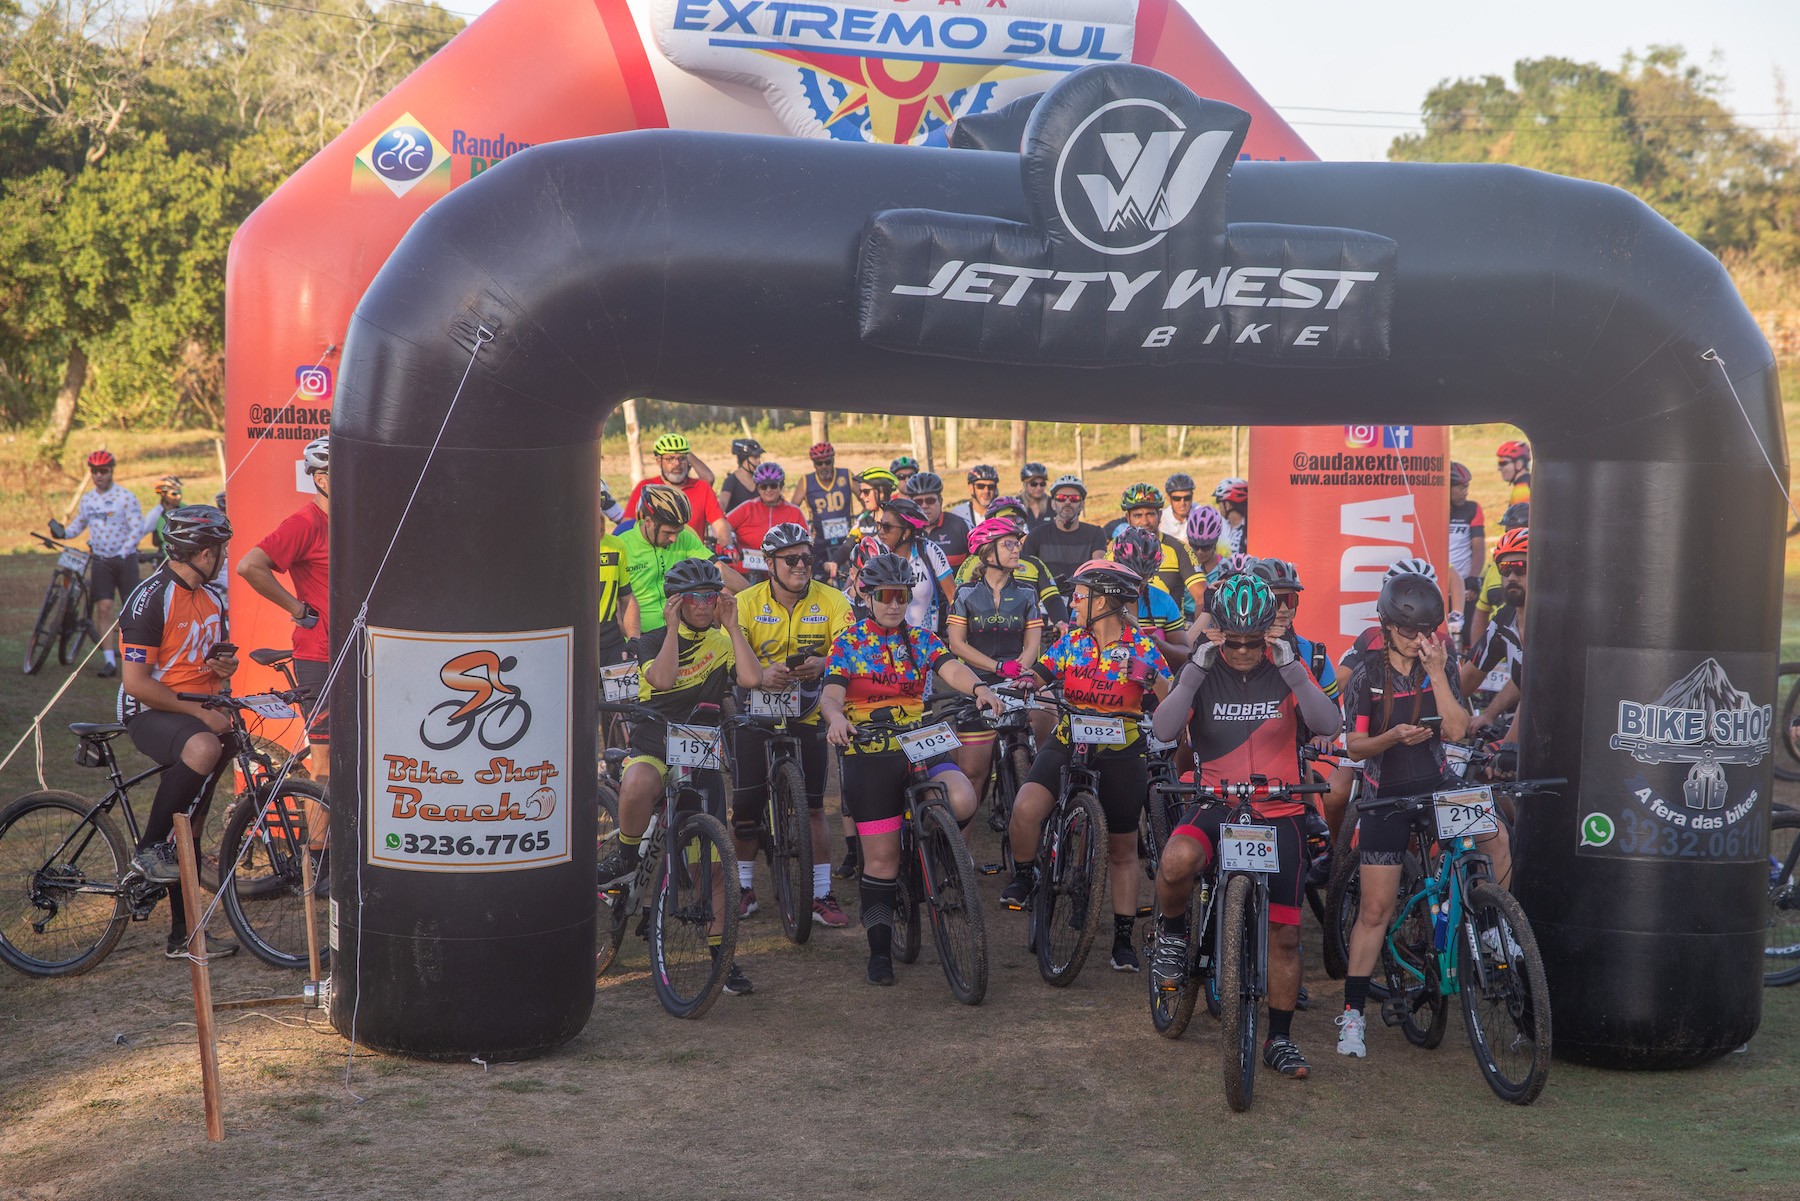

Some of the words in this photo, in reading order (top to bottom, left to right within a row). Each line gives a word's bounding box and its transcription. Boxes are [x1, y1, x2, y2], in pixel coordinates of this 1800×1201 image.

[673, 0, 992, 49] EXTREMO
[1003, 21, 1124, 61] SUL
[890, 260, 1158, 312] JETTY
[1161, 266, 1380, 312] WEST
[1140, 322, 1330, 349] BIKE
[1293, 452, 1444, 472] @audaxextremosul
[926, 539, 946, 567] TRAVA
[1091, 680, 1114, 691] TEM
[763, 693, 791, 705] 072
[1064, 688, 1124, 707] GARANTIA
[1212, 700, 1280, 716] NOBRE
[1084, 726, 1115, 737] 082
[1619, 700, 1706, 743] BIKE
[1713, 704, 1772, 745] SHOP
[679, 740, 711, 755] 157
[915, 734, 946, 750] 103
[383, 754, 464, 784] Bike
[474, 756, 559, 785] Shop
[386, 785, 526, 822] Beach
[1450, 804, 1483, 822] 210
[1635, 787, 1652, 804] A
[1650, 798, 1686, 827] fera
[1691, 814, 1723, 829] das
[1727, 789, 1758, 825] bikes
[403, 830, 550, 856] 3236.7765
[1619, 807, 1763, 857] 3232.0610
[1235, 842, 1267, 857] 128
